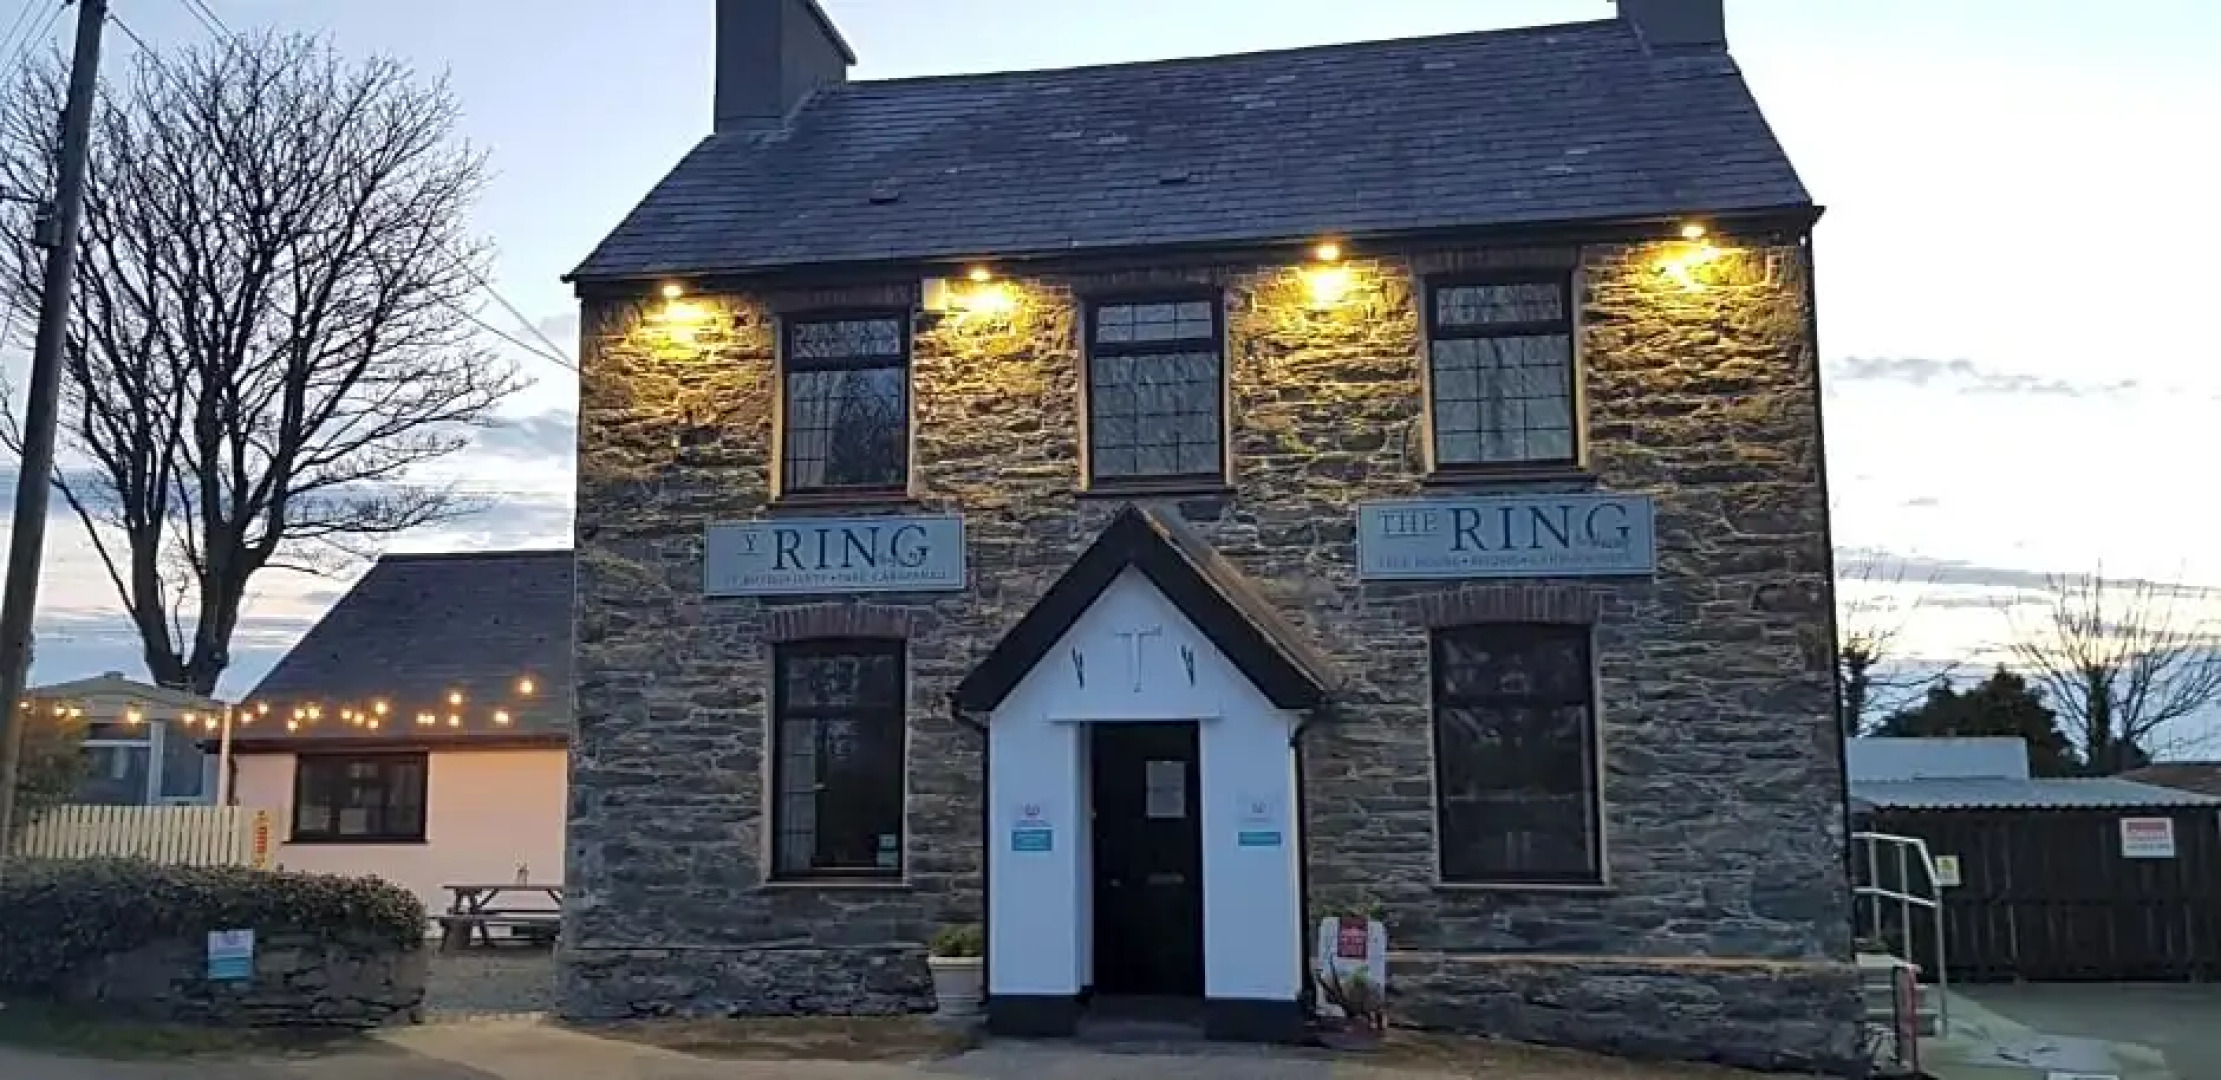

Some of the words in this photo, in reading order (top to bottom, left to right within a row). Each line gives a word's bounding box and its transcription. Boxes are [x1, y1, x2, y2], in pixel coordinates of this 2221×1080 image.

[772, 524, 930, 570] RING
[1379, 511, 1437, 533] THE
[1449, 503, 1630, 551] RING
